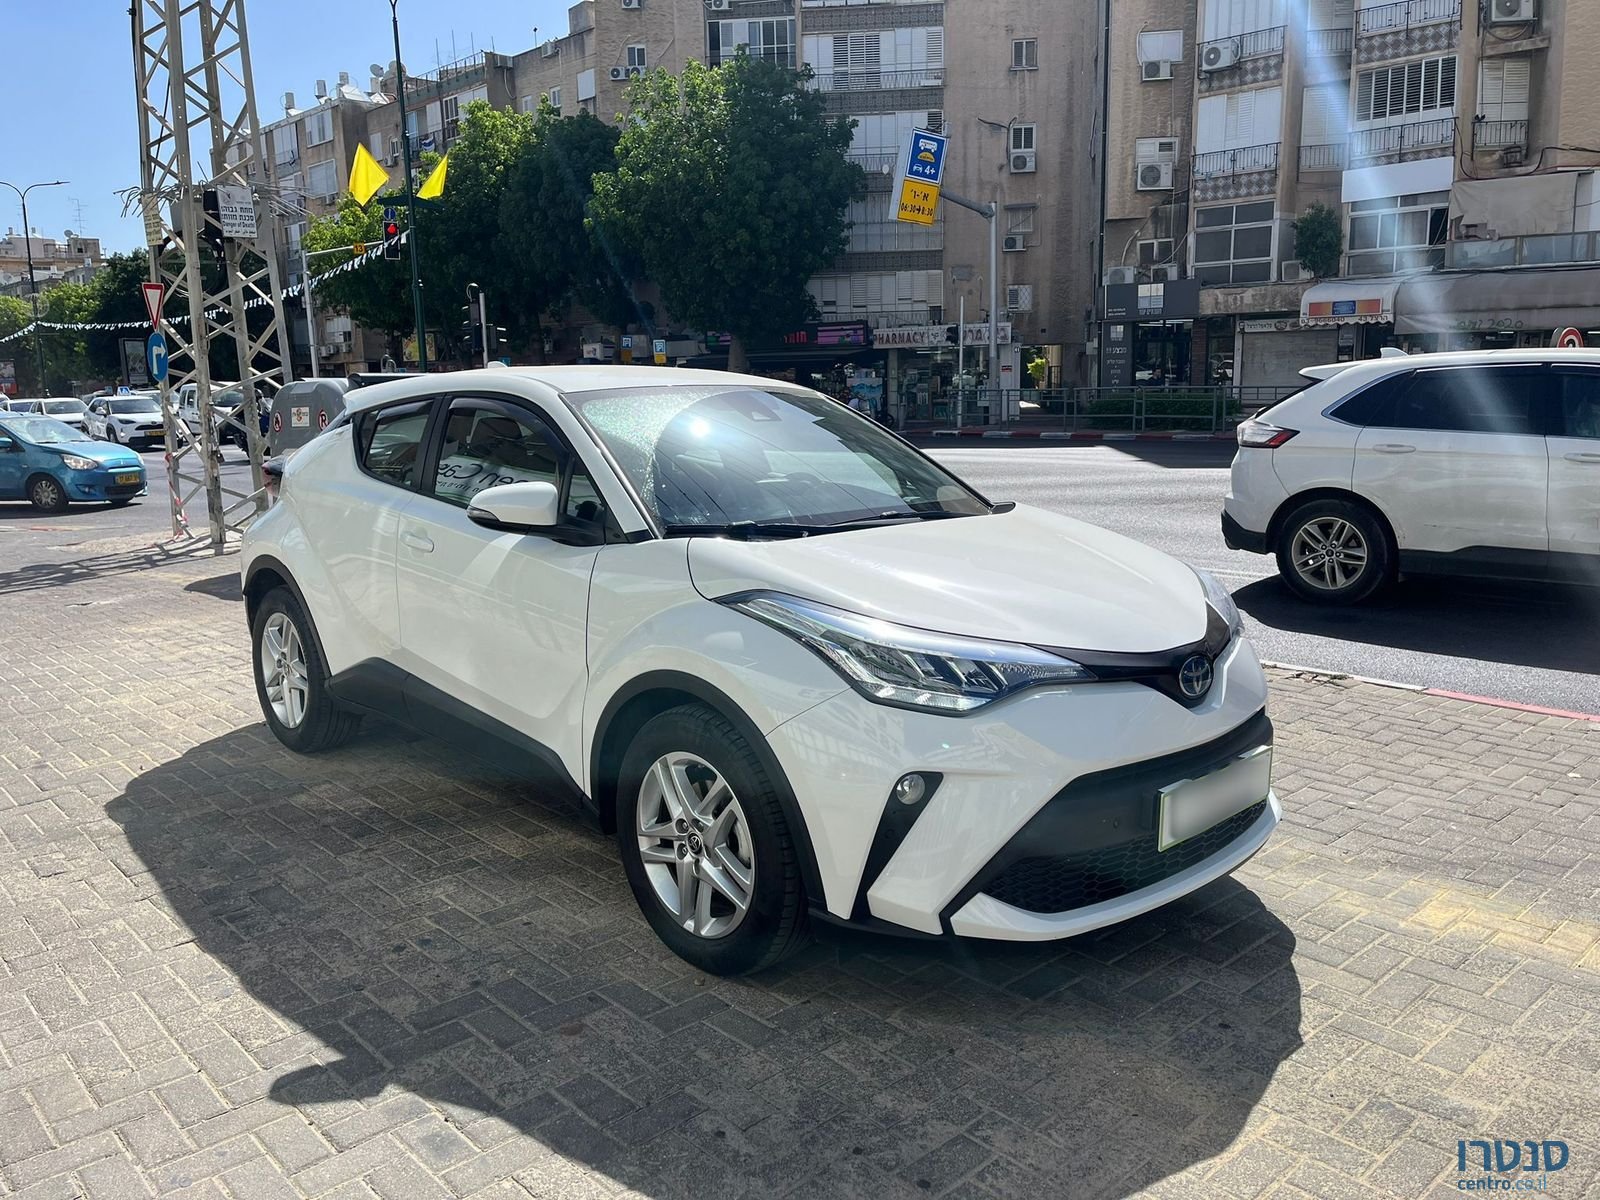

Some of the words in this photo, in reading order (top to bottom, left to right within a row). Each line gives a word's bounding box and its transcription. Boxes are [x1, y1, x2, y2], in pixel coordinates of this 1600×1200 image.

[924, 165, 936, 175] 4+
[1487, 318, 1524, 330] 2020
[873, 330, 926, 346] PHARMACY
